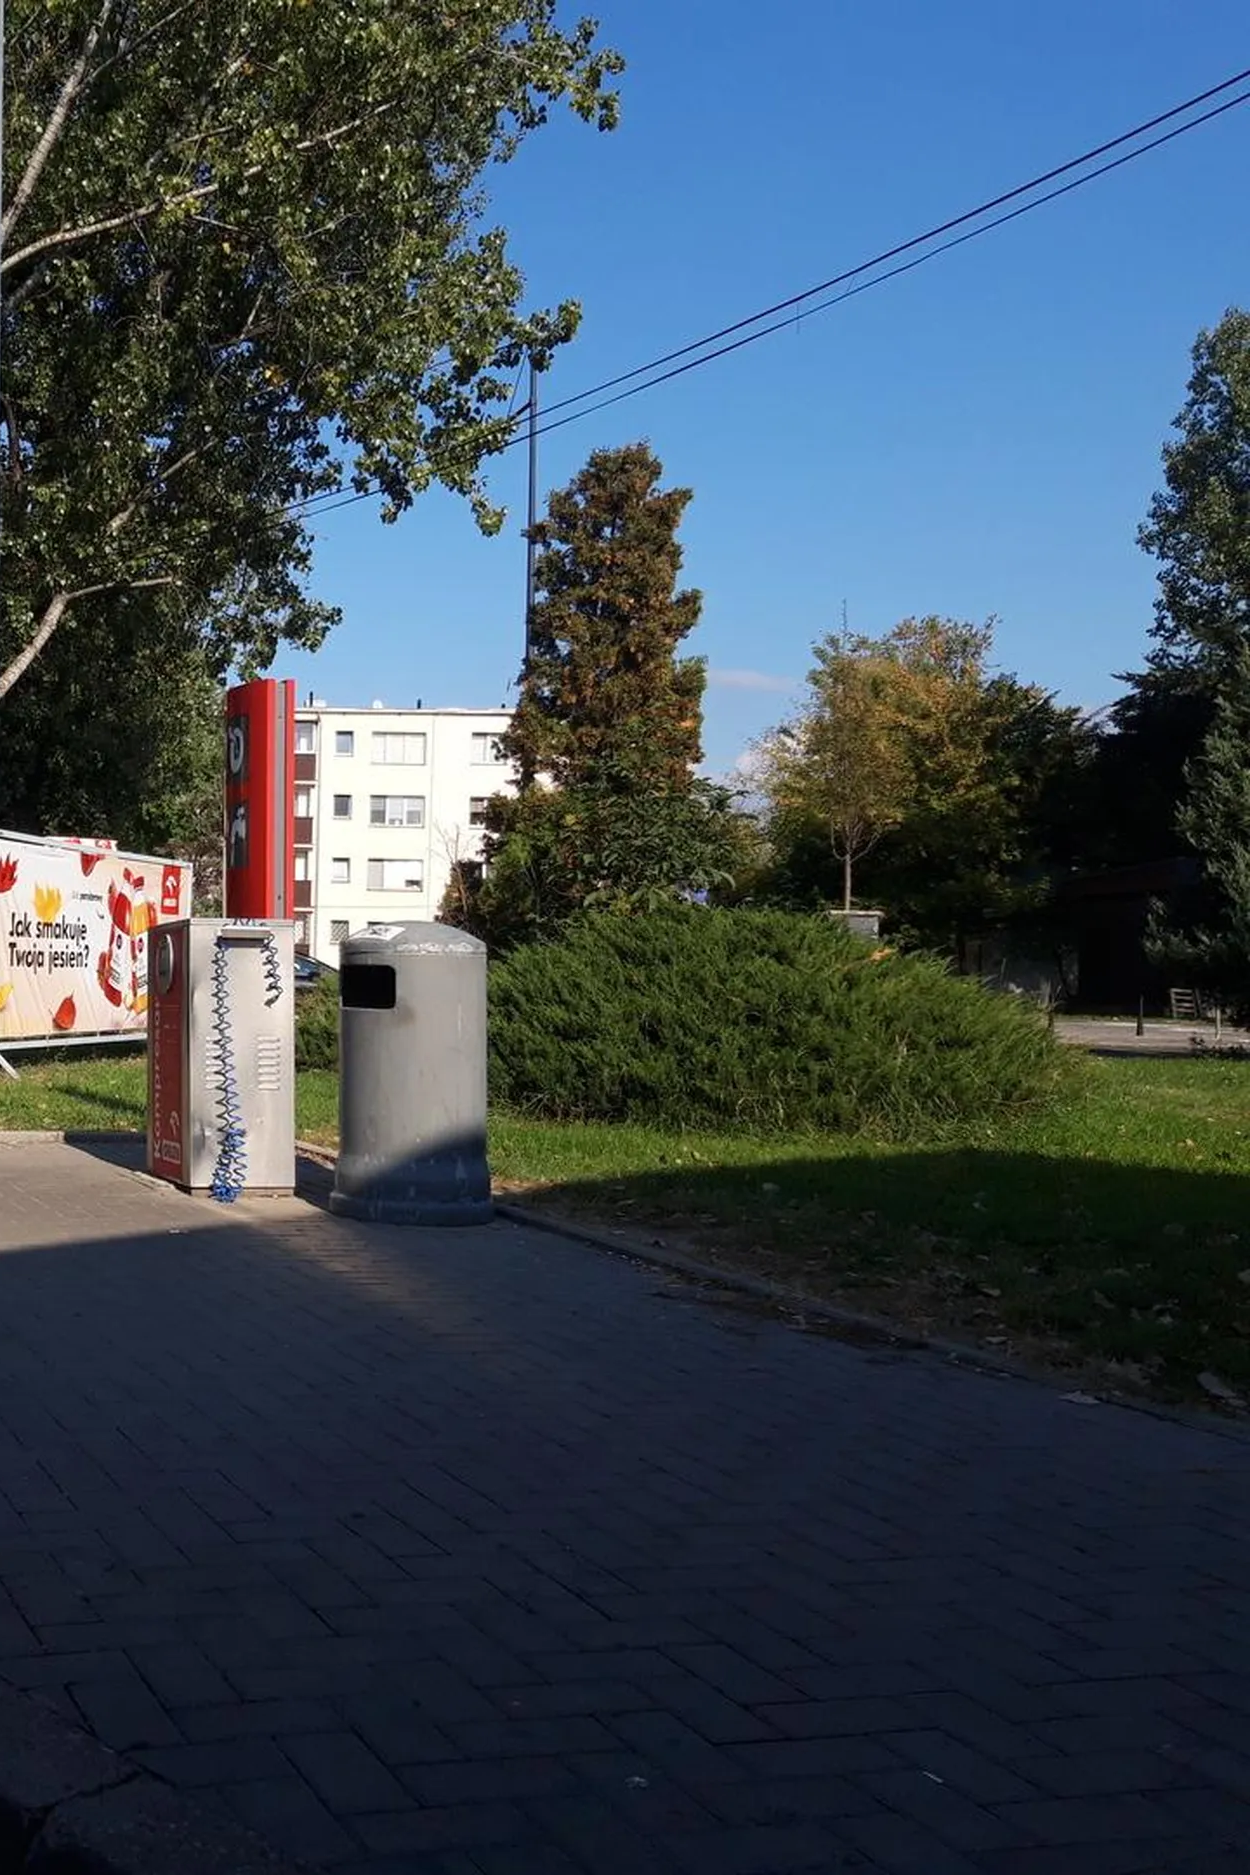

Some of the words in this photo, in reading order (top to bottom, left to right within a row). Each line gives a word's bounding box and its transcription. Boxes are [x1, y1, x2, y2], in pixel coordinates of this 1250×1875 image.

[9, 912, 31, 937] Jak
[36, 914, 87, 946] smakuje
[9, 942, 44, 974] Twoja
[48, 944, 90, 974] jesień?
